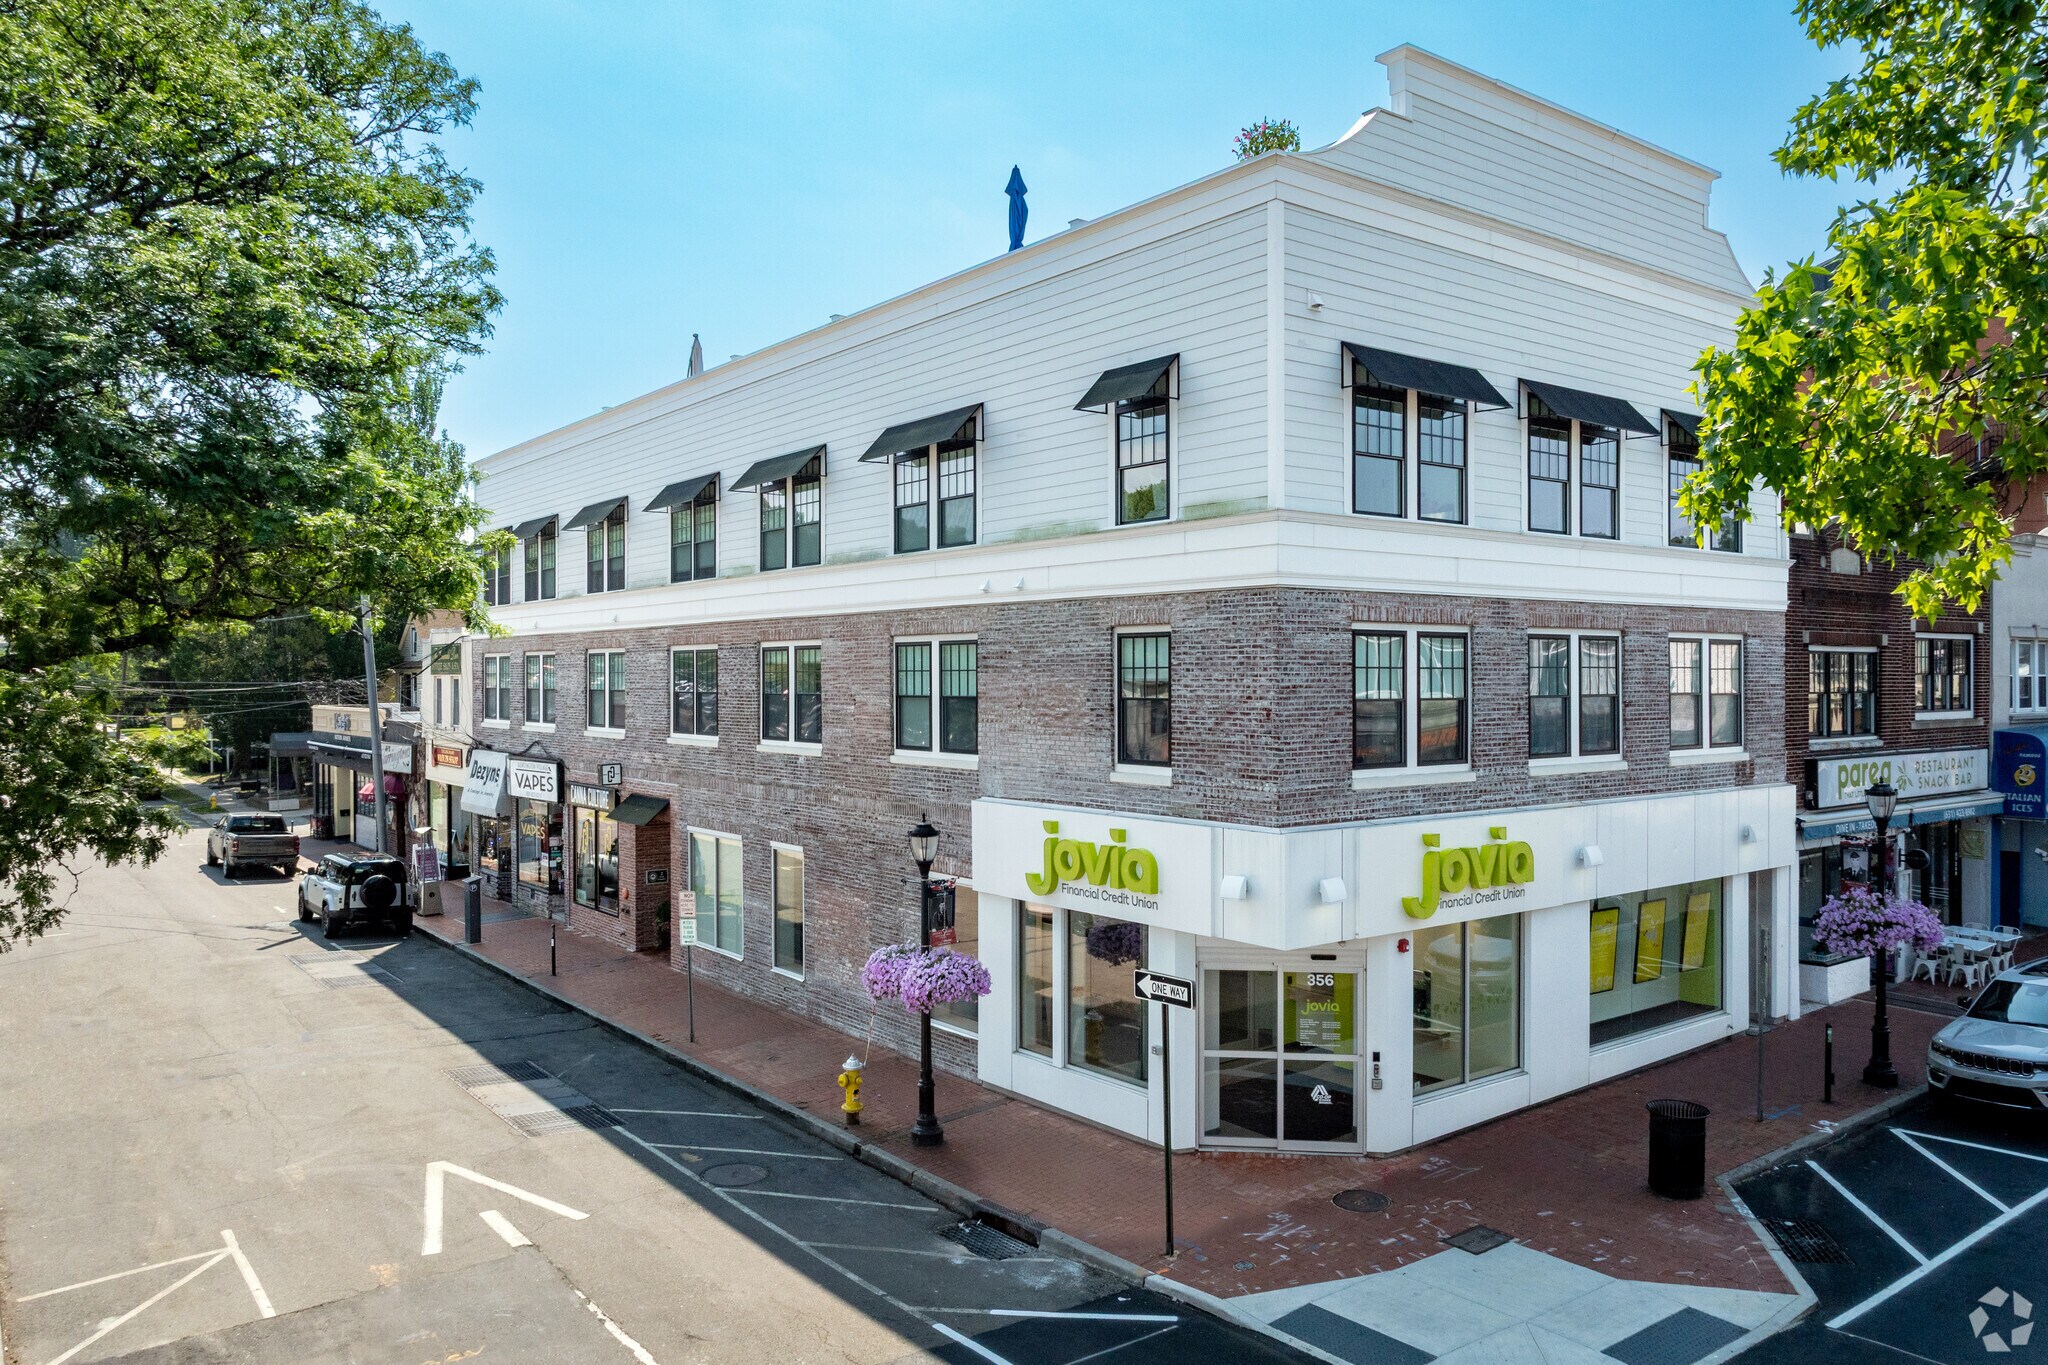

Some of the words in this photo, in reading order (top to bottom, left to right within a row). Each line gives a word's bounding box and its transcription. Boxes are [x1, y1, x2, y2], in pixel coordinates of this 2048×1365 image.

[470, 760, 500, 786] Dezyns
[1915, 756, 1974, 773] RESTAURANT
[515, 773, 554, 793] VAPES
[1838, 761, 1891, 799] parea
[1918, 775, 1950, 789] SNACK
[1955, 772, 1972, 786] BAR
[2012, 804, 2033, 812] ICES
[521, 822, 545, 839] VAPES
[1836, 823, 1849, 833] DINE
[1850, 822, 1856, 831] IN
[1025, 820, 1158, 896] jovia
[1402, 826, 1534, 919] jovia
[1061, 883, 1099, 900] Financial
[1101, 890, 1129, 905] Credit
[1131, 895, 1159, 910] Union
[1475, 889, 1501, 904] Credit
[1503, 887, 1526, 900] Union
[1307, 974, 1334, 986] 356
[1152, 982, 1167, 995] ONE
[1170, 986, 1186, 999] WAY
[1300, 999, 1340, 1015] jovia
